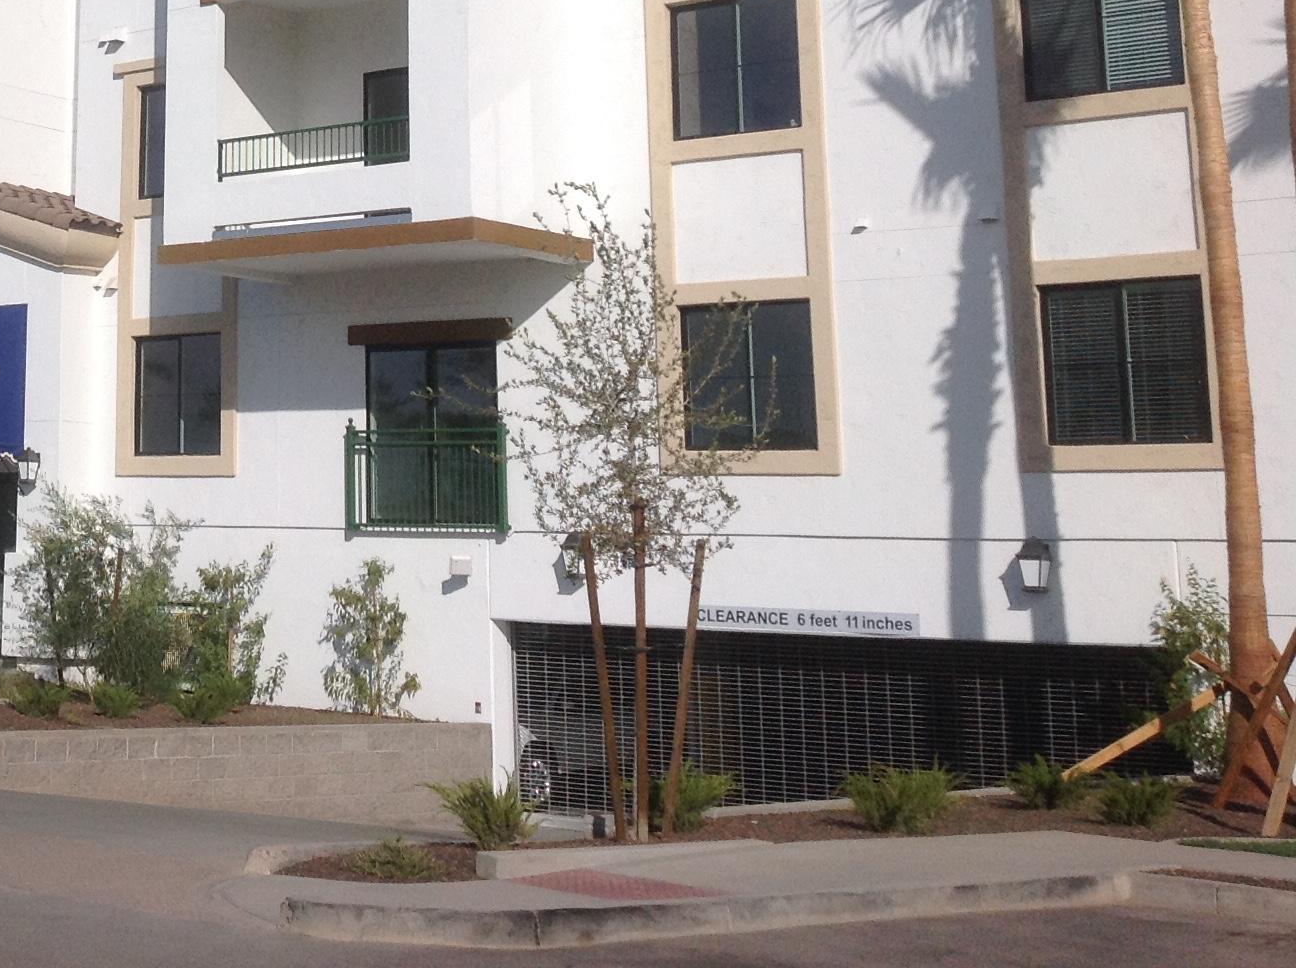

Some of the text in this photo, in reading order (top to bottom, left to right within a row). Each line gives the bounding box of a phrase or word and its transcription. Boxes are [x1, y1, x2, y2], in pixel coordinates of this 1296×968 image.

[697, 609, 913, 632] CLEARANCE 6 feet 11 inches
